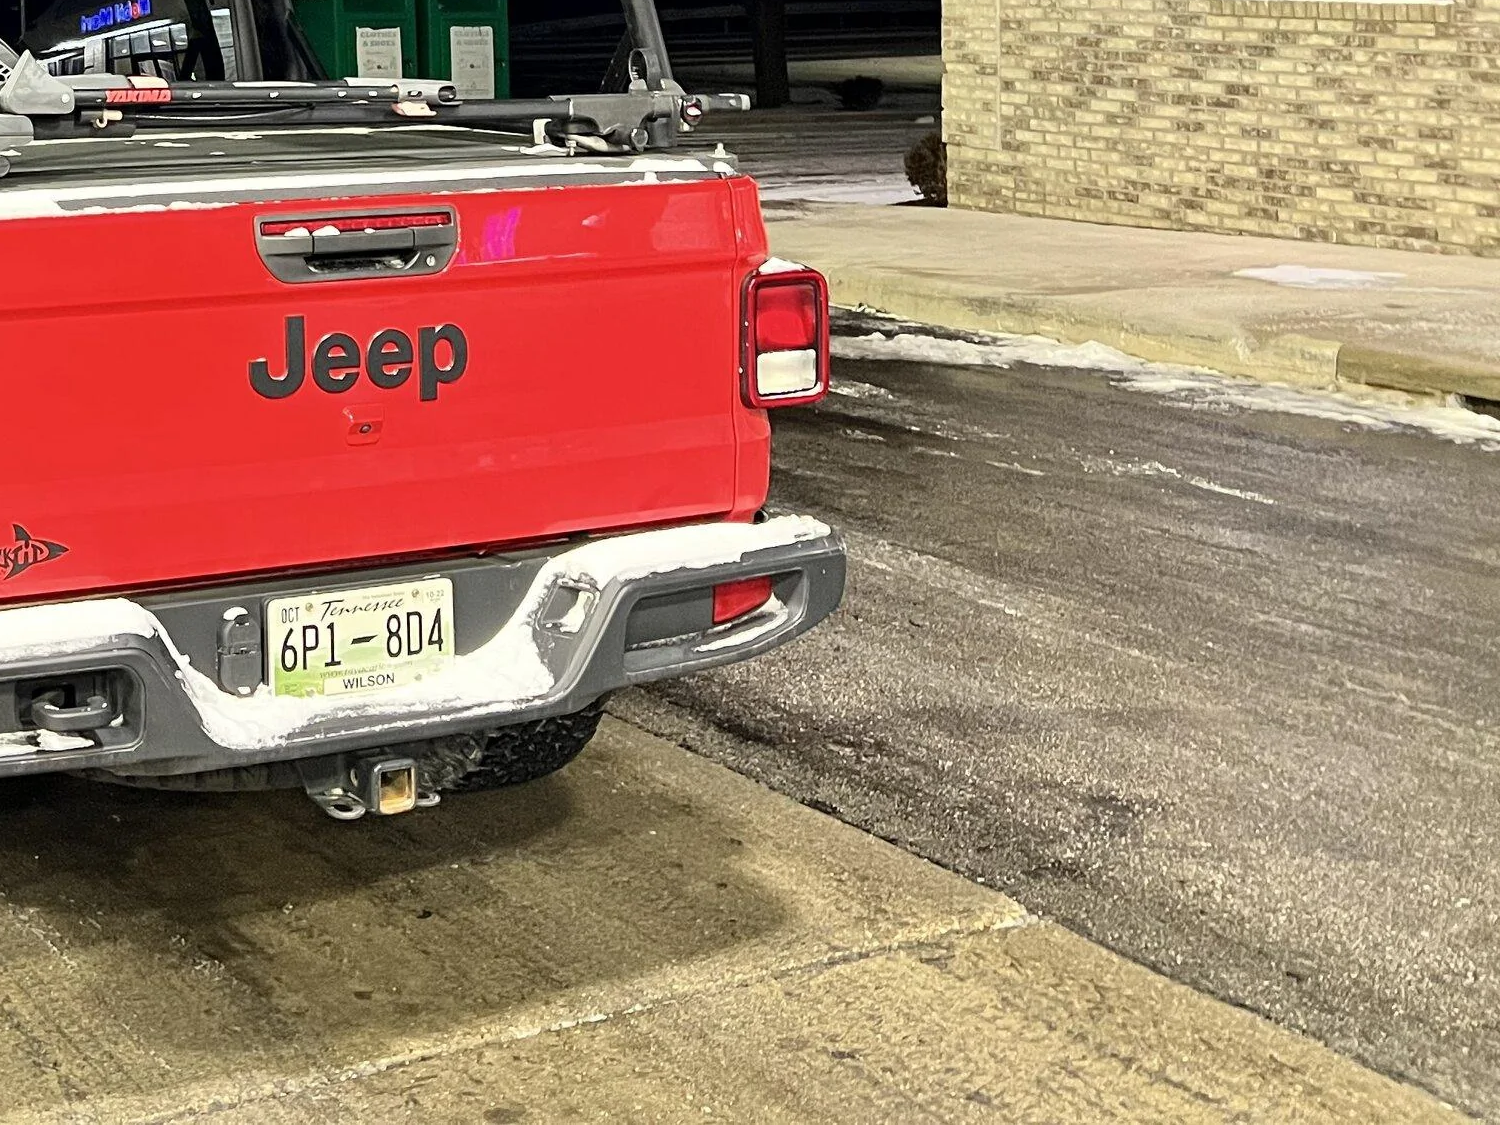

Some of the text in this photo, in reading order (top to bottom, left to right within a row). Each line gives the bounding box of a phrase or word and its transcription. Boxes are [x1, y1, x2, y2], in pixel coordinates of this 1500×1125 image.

[105, 89, 172, 103] YAKIMA
[248, 315, 468, 402] Jeep
[281, 606, 300, 624] OCT
[320, 597, 404, 622] Tennessee
[342, 672, 396, 690] WILSON
